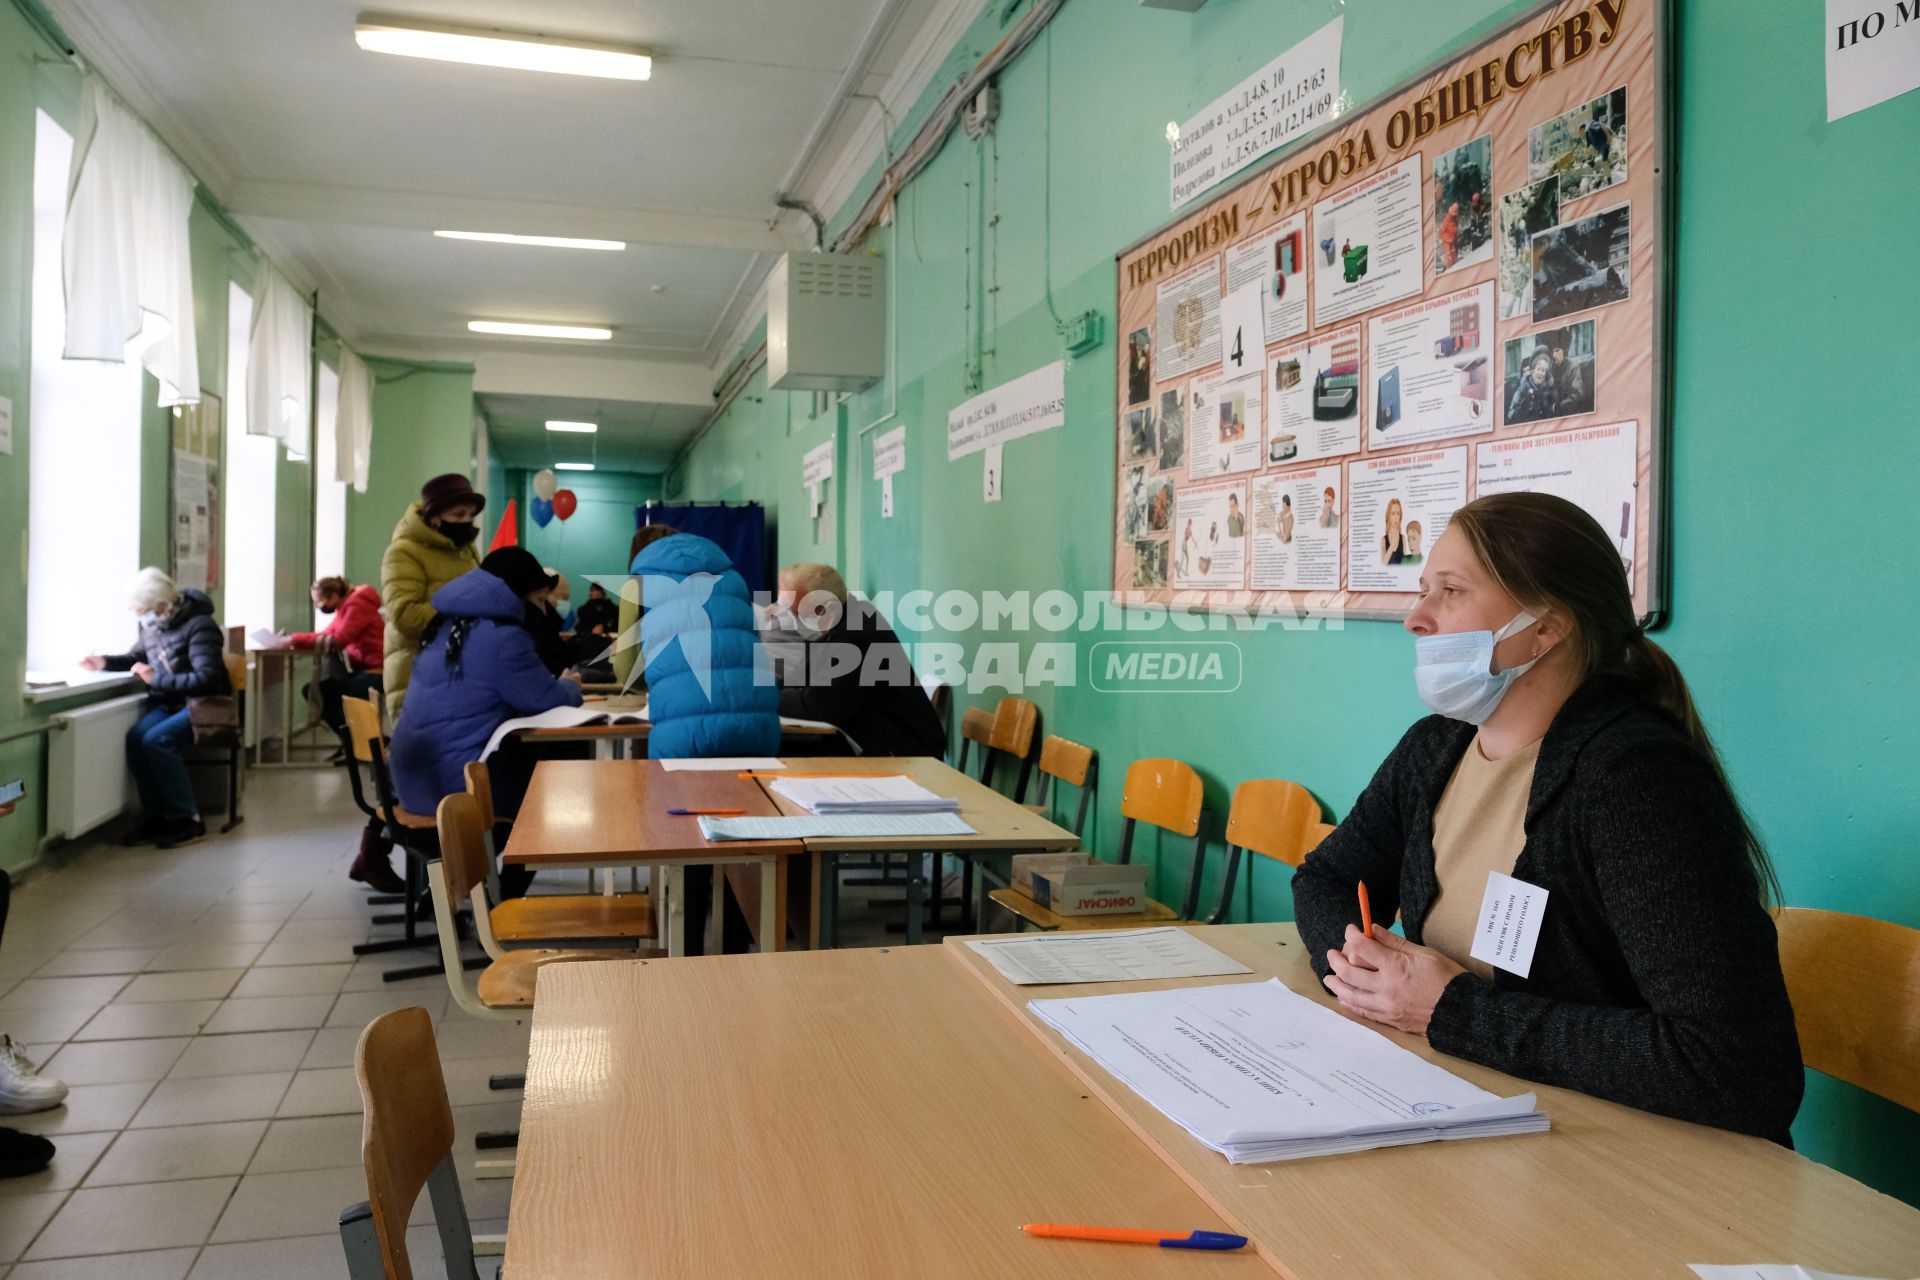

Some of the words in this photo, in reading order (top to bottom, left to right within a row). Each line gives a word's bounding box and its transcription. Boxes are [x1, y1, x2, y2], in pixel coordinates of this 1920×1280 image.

[1835, 12, 1885, 51] ПО
[1273, 67, 1285, 88] 10
[1127, 203, 1240, 289] ТЕРРОРИЗМ
[1270, 128, 1377, 212] УГРОЗА
[1386, 0, 1627, 151] ОБЩЕСТВУ
[1230, 324, 1243, 367] 4
[1503, 458, 1513, 466] 02
[988, 469, 994, 496] 3
[1076, 896, 1136, 909] ОФИСМАГ
[1495, 939, 1504, 956] ЧЛЕН
[1504, 894, 1515, 920] ПРАВОМ
